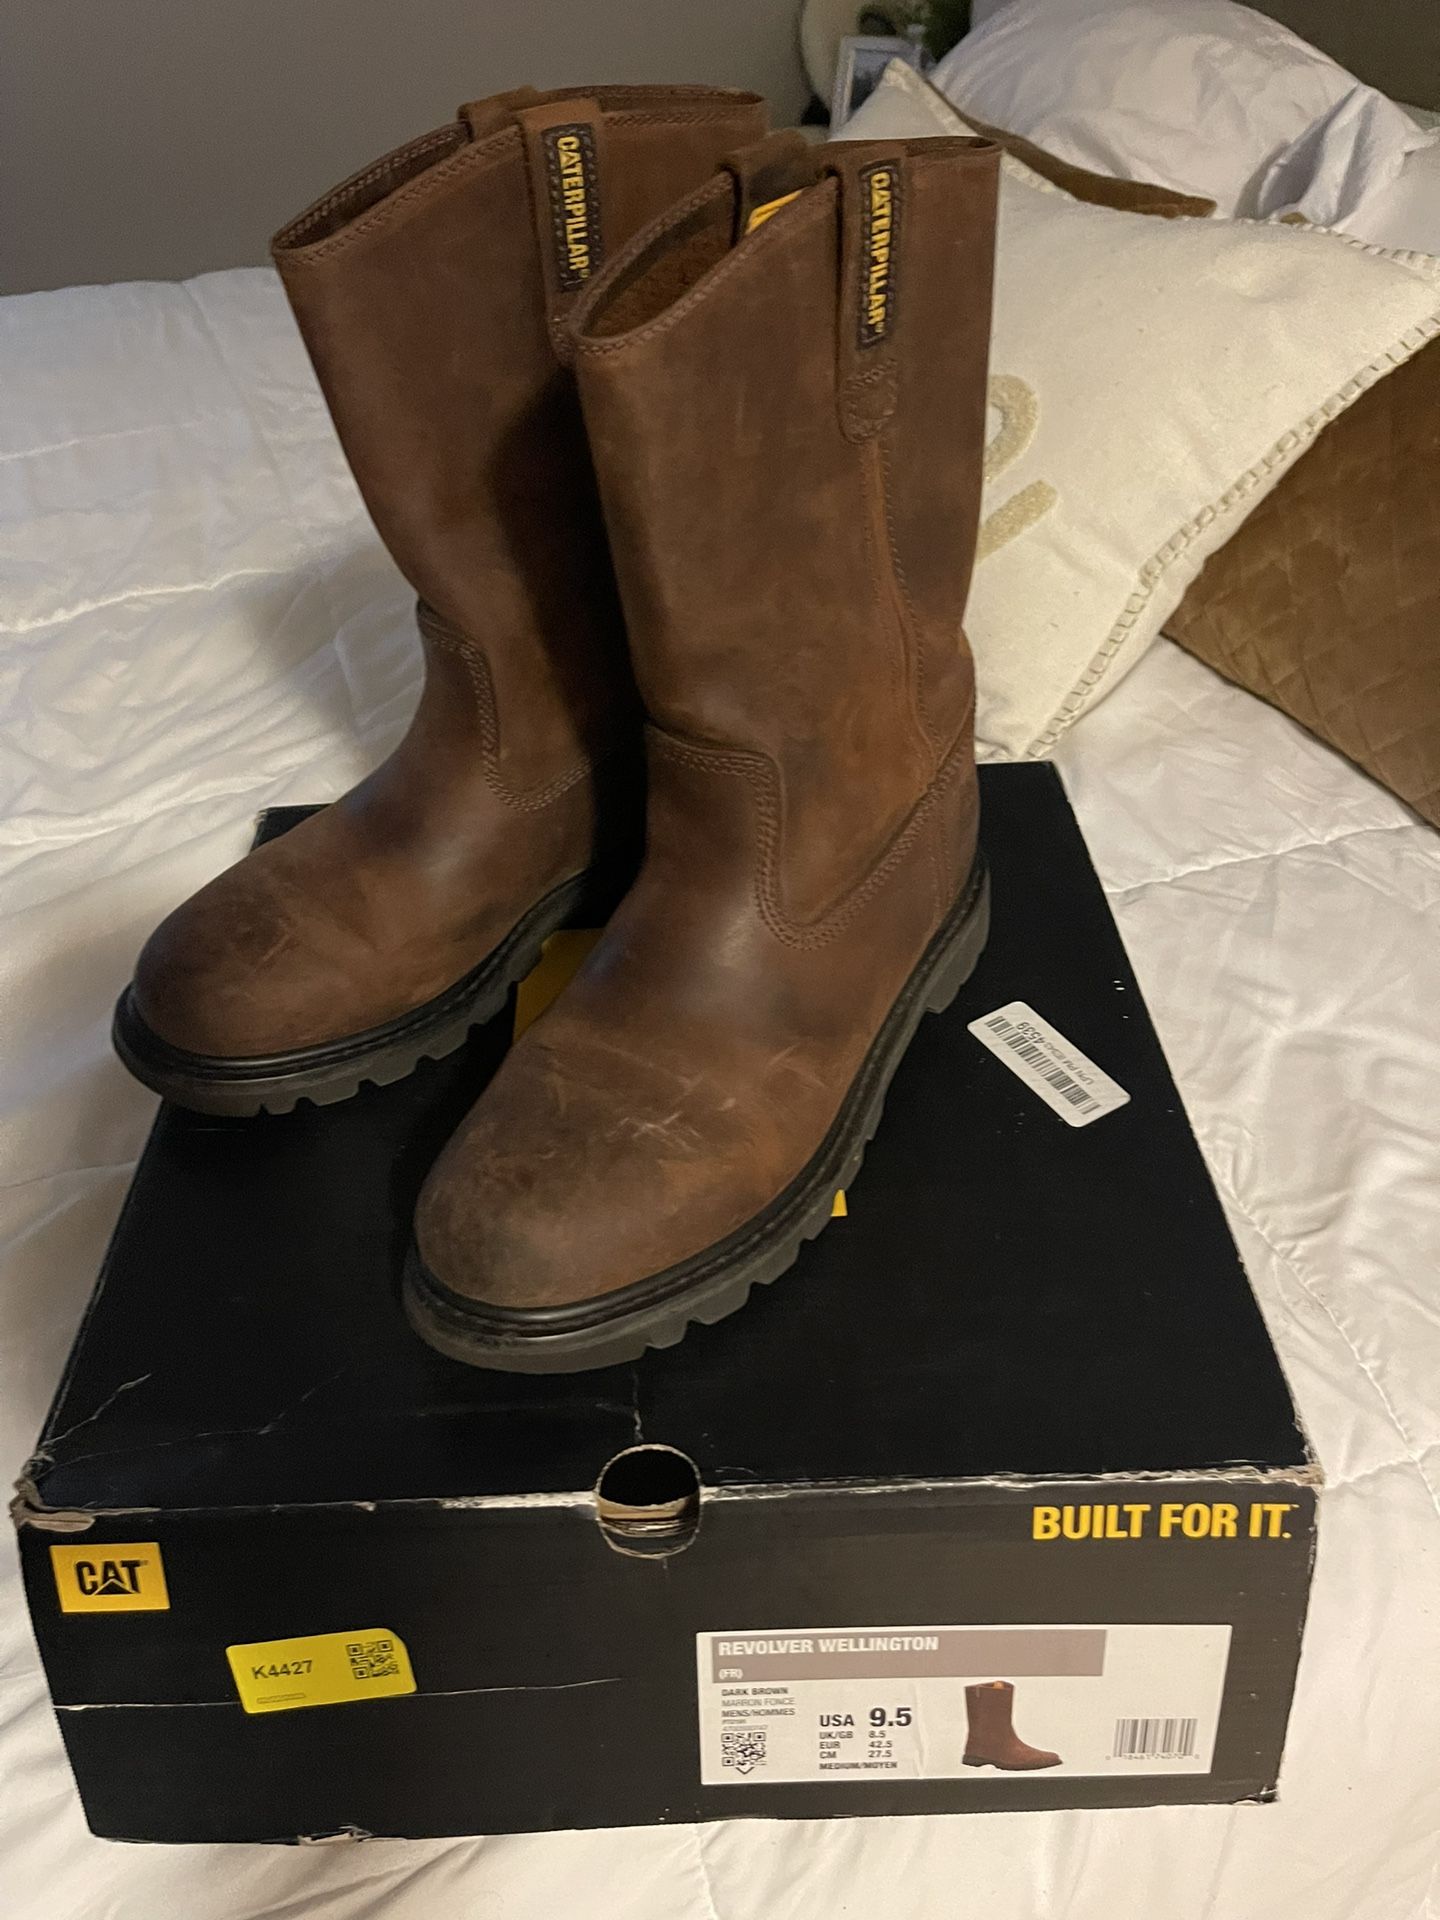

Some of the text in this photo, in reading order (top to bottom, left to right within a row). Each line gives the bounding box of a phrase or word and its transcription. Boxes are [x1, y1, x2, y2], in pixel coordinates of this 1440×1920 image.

[557, 136, 590, 271] CATERPILLAR
[868, 171, 892, 326] CATERPILLAR
[1032, 1504, 1152, 1540] BUILT
[1159, 1503, 1240, 1538] FOR
[75, 1560, 142, 1596] CAT
[718, 1636, 939, 1656] REVOLVER WELLINGTON
[252, 1659, 313, 1680] K4427
[718, 1668, 744, 1680] (FR)
[721, 1687, 788, 1697] DARK BROWN
[721, 1699, 762, 1707] MARRON
[721, 1708, 796, 1717] MENS/HOMMES
[819, 1707, 912, 1727] USA 9.5
[819, 1730, 886, 1740] UK/GB 8.5
[819, 1740, 893, 1749] EUR 42.5
[819, 1750, 892, 1759] CM 27.5
